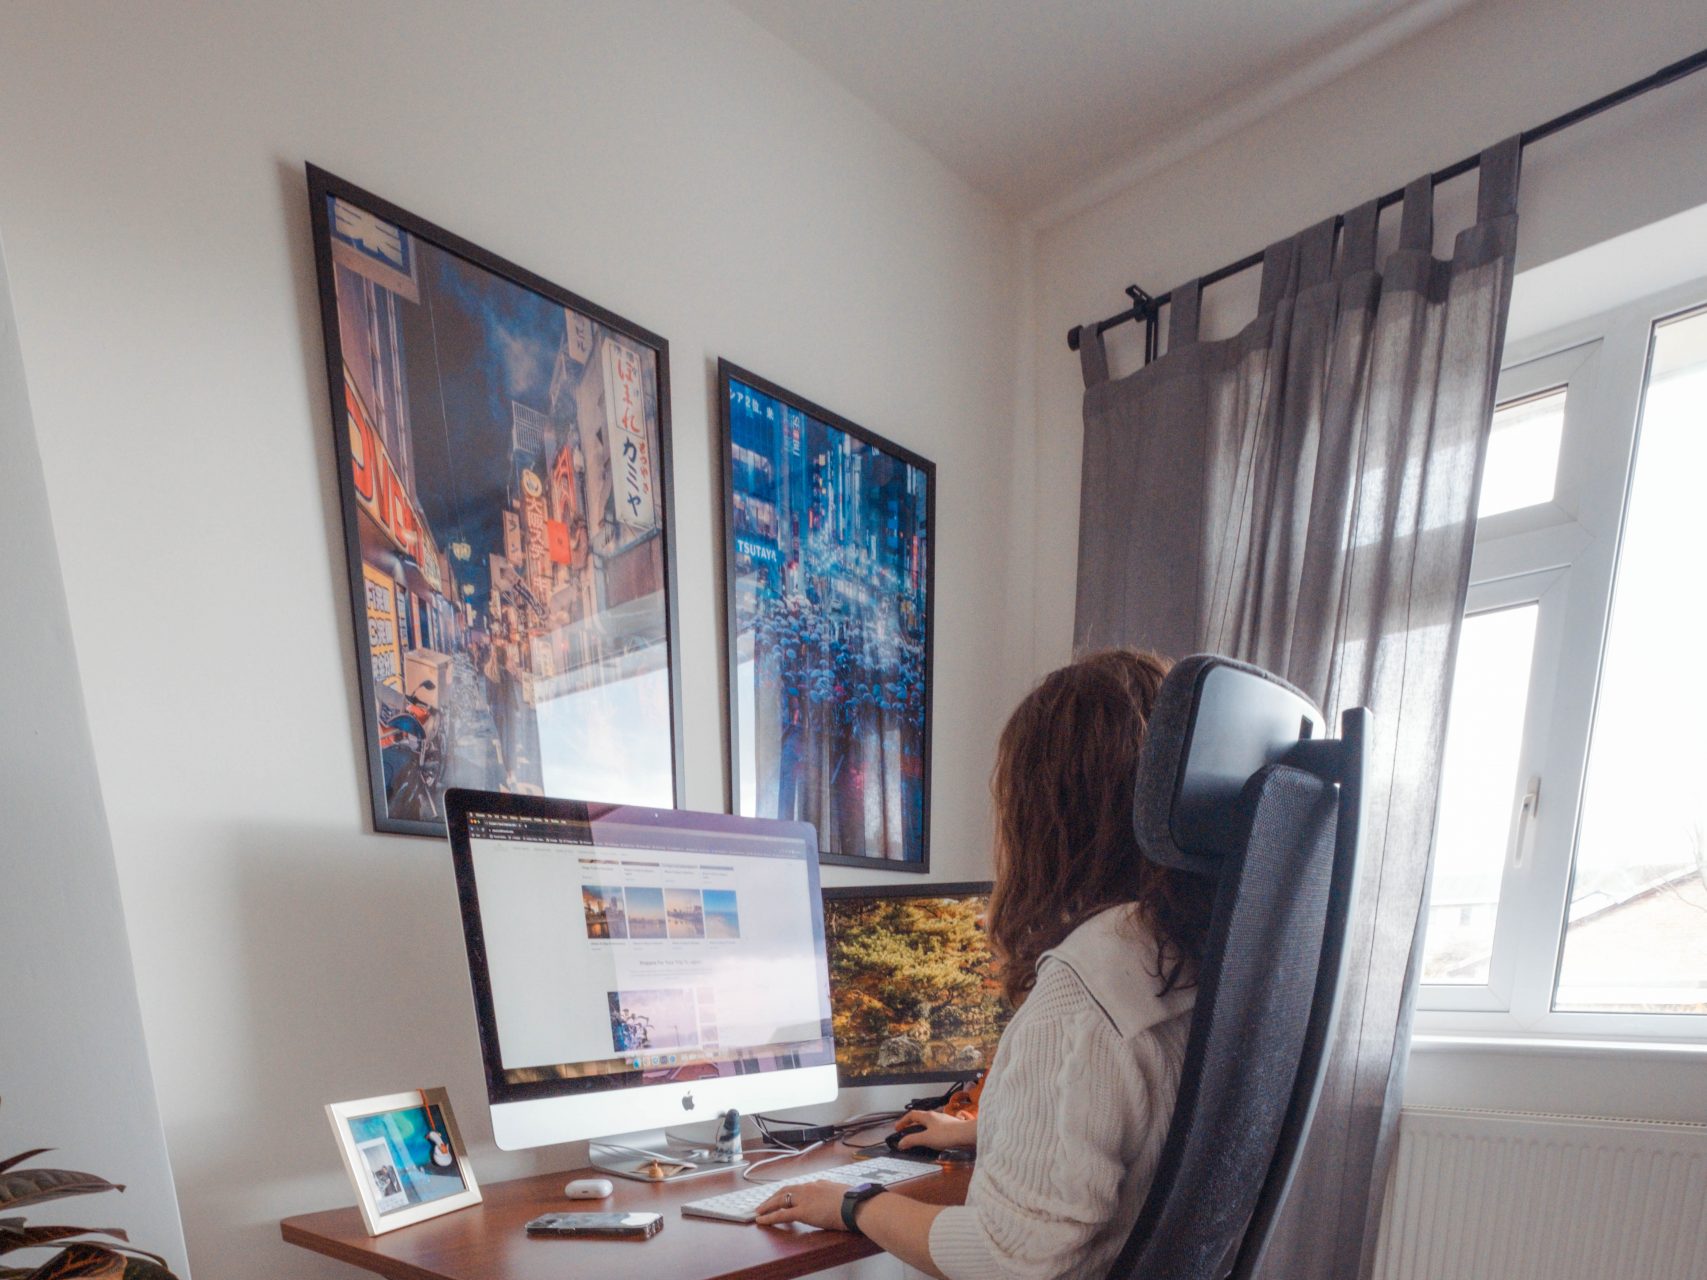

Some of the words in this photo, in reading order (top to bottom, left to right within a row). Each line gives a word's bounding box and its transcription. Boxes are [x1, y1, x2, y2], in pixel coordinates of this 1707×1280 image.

[623, 436, 641, 517] カミヤ
[737, 539, 777, 563] TSUTAYA
